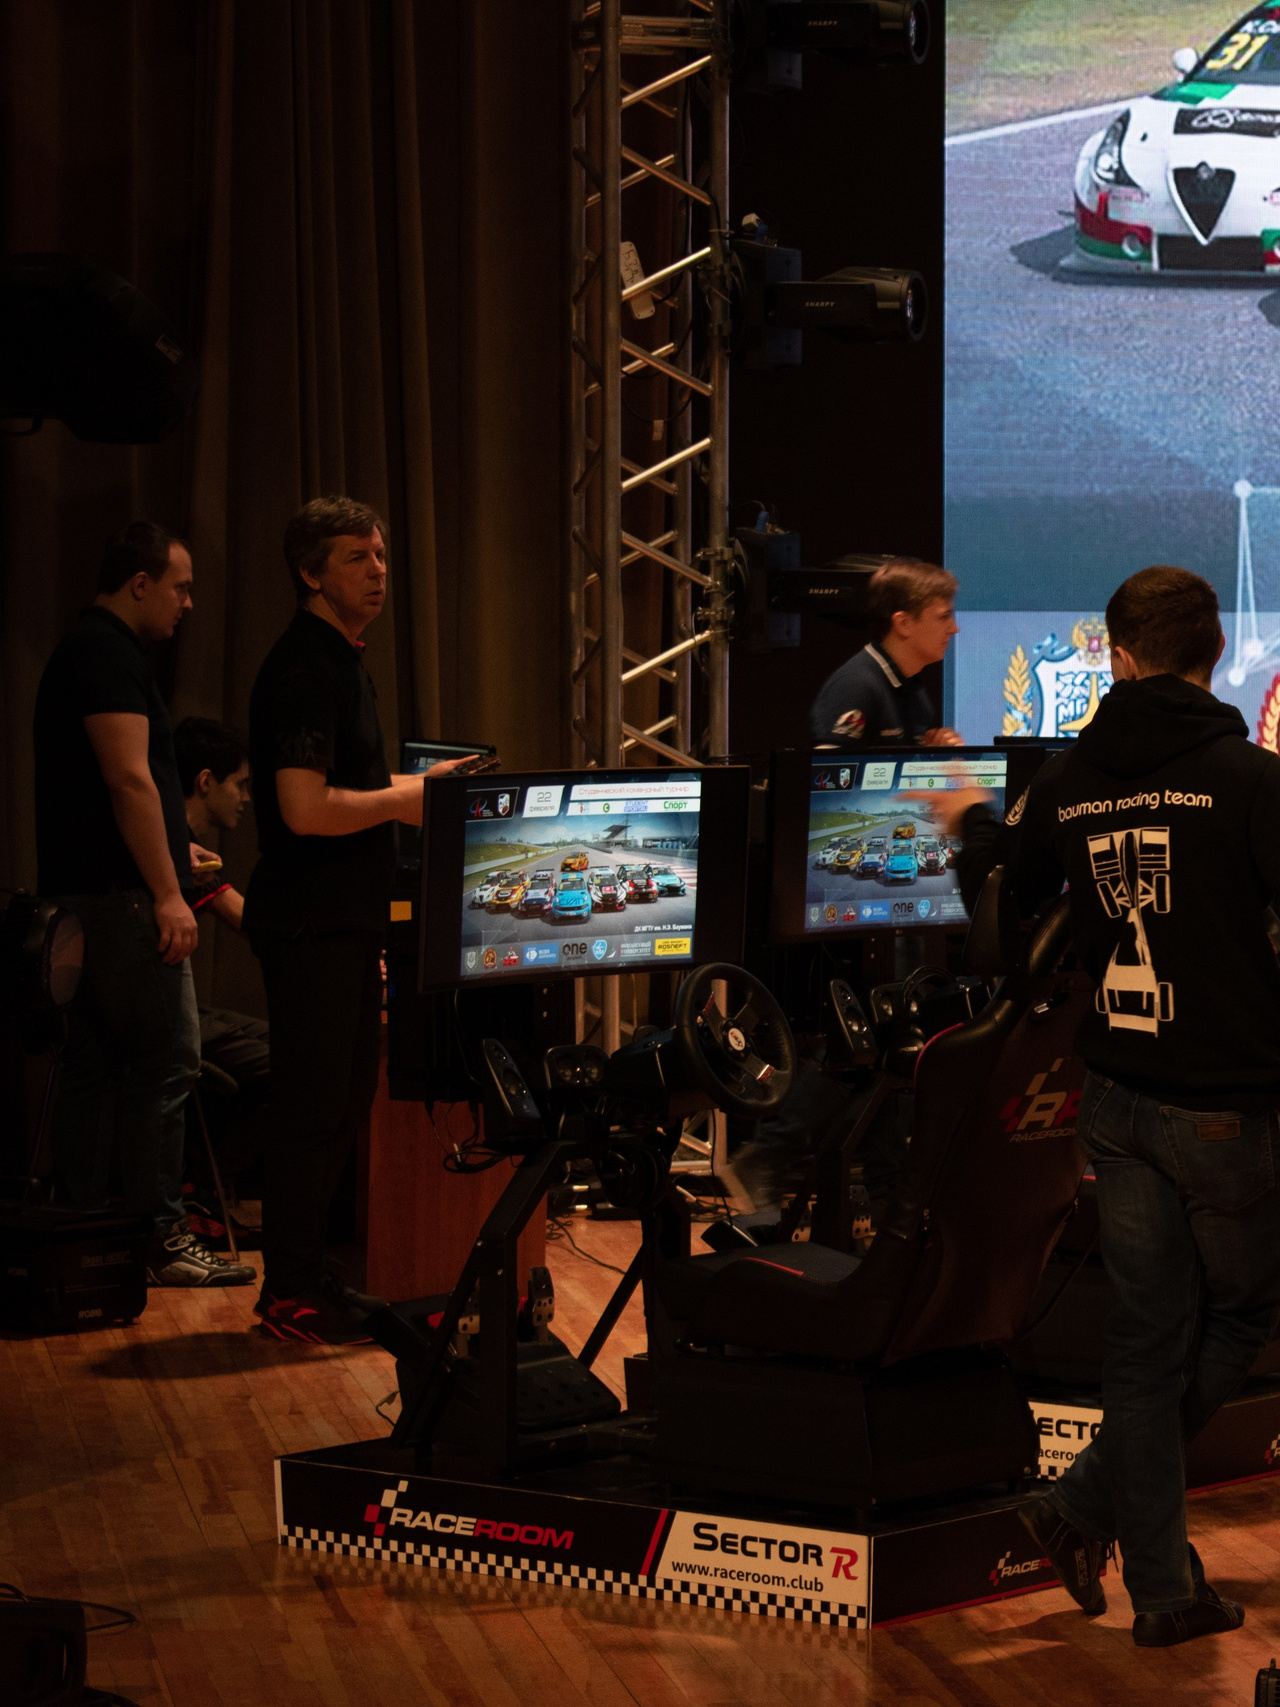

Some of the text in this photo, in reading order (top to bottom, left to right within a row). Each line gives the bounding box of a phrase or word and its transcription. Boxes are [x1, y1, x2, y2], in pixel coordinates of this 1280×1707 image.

[807, 20, 838, 28] SHARPY
[1205, 33, 1269, 71] 31
[873, 767, 886, 777] 22
[537, 791, 552, 803] 22
[664, 800, 688, 811] Спорт
[1058, 789, 1213, 823] bauman racing team
[893, 901, 914, 914] one
[563, 942, 588, 956] one
[389, 1508, 575, 1550] RACEROOM
[1001, 1557, 1053, 1579] RACER
[671, 1558, 825, 1593] www.raceroom.club
